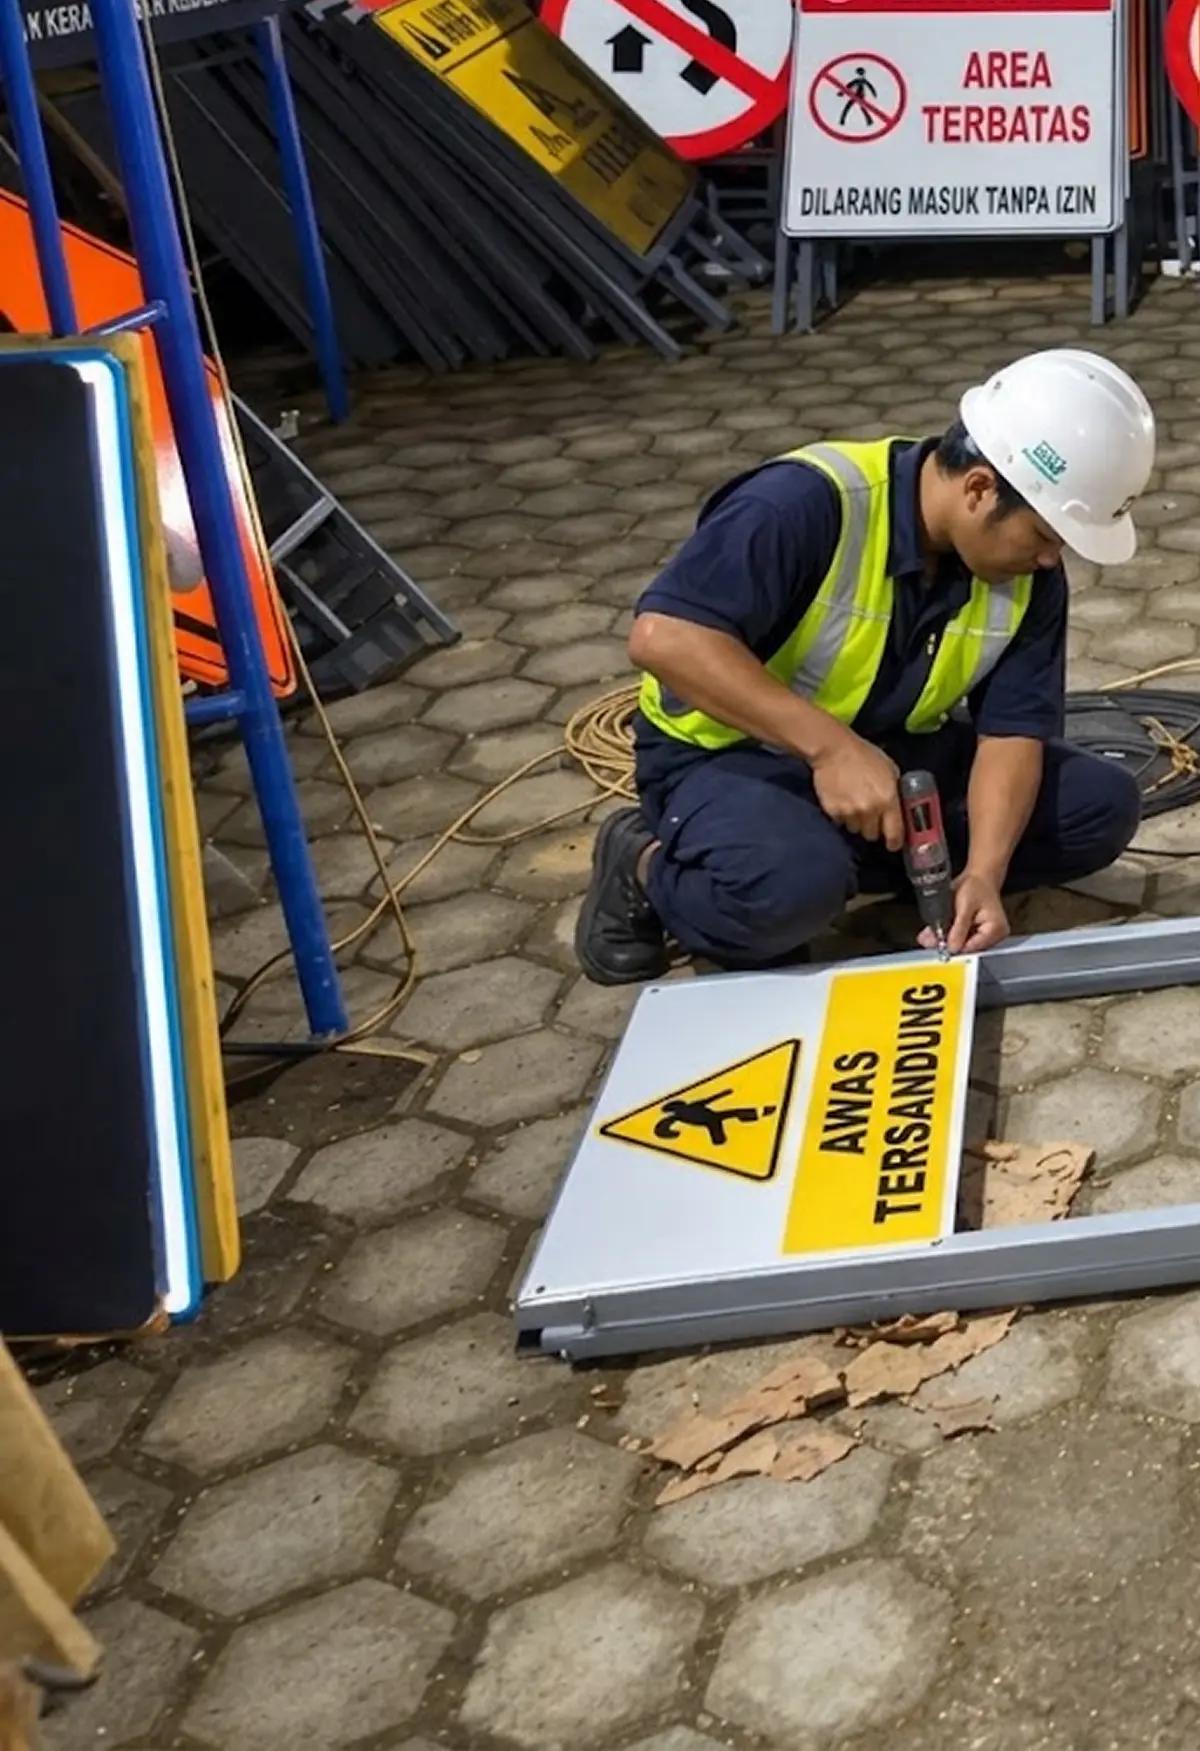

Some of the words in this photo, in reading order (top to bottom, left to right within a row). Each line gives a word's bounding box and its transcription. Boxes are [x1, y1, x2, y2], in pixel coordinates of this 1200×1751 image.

[963, 51, 1052, 88] AREA
[922, 105, 1090, 143] TERBATAS
[801, 187, 901, 216] DILARANG
[908, 186, 979, 215] MASUK
[986, 186, 1050, 214] TANPA
[1056, 186, 1096, 214] IZIN
[819, 1050, 879, 1155] AWAS
[874, 983, 945, 1225] TERSANDUNG
